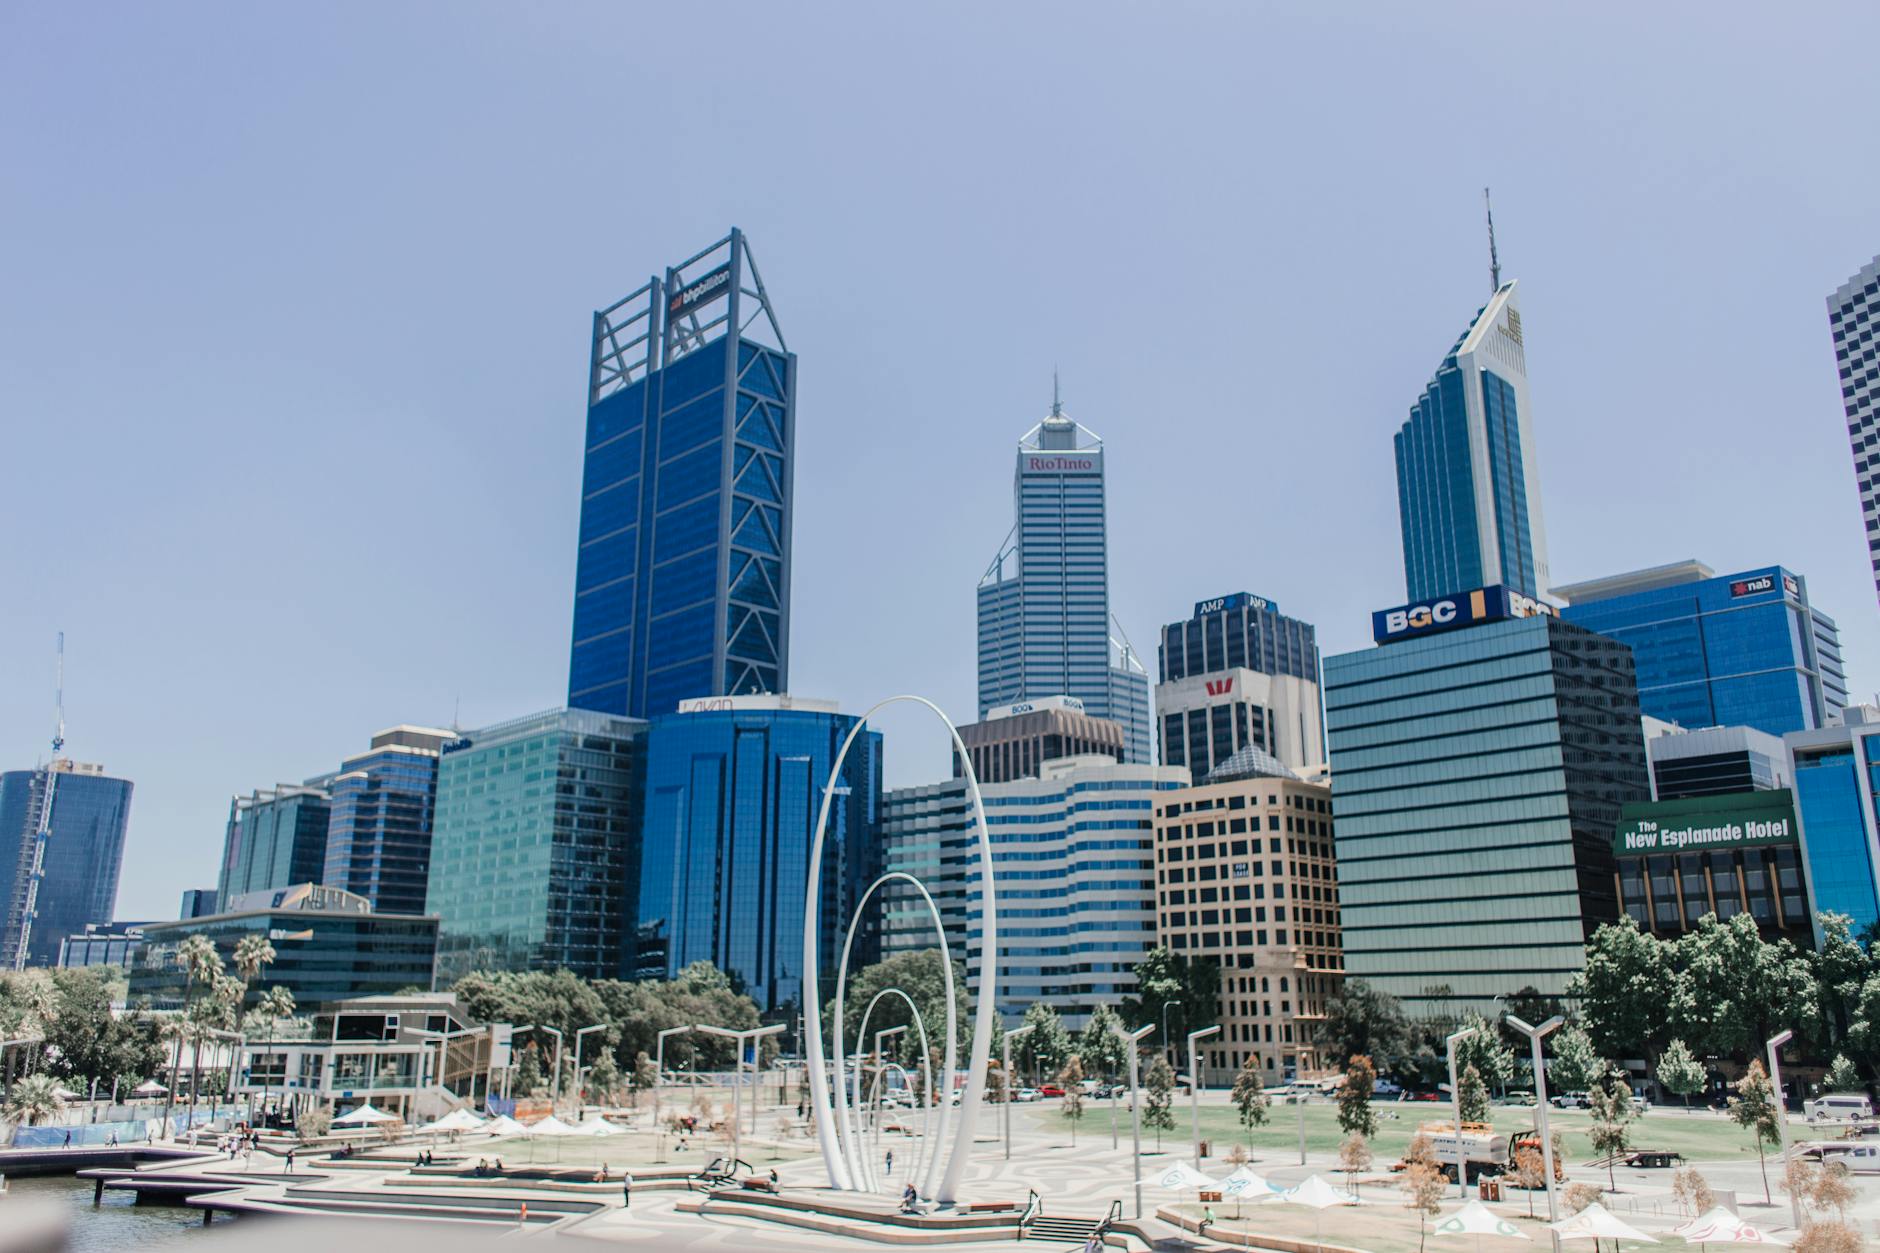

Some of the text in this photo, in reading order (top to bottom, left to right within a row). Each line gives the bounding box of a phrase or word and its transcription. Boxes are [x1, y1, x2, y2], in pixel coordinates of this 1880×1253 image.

[1748, 579, 1771, 591] nab
[1200, 599, 1224, 614] AMP
[1386, 600, 1457, 634] BGC
[1625, 819, 1789, 849] New Esplanade Hotel
[1638, 821, 1658, 832] The
